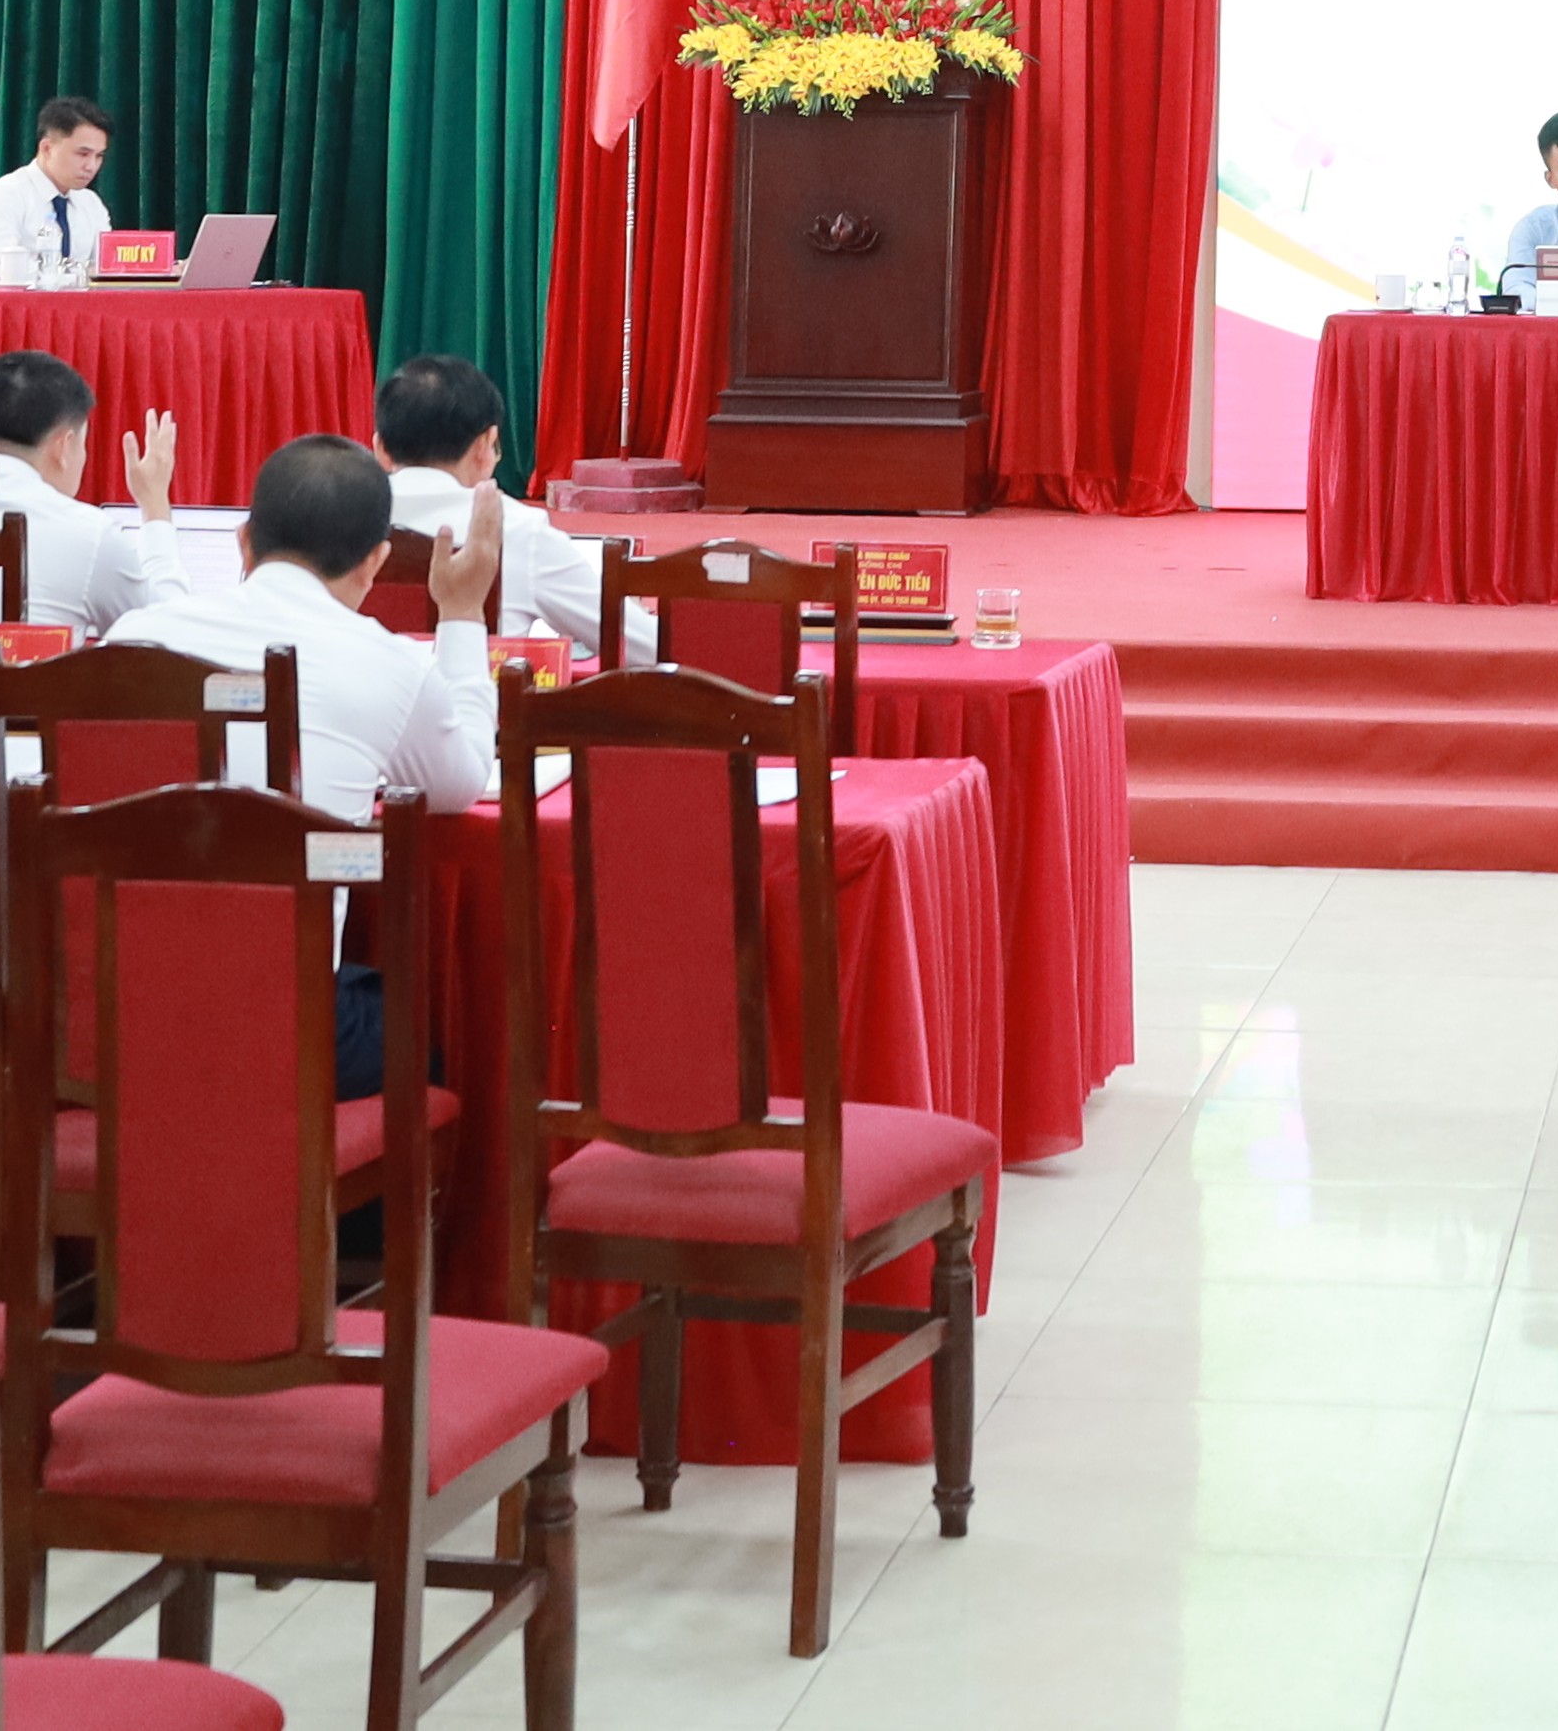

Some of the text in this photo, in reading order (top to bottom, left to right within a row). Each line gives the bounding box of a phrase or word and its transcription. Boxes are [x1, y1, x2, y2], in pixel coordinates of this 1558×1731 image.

[116, 242, 156, 263] THƯ KÝ
[878, 571, 902, 591] ĐỨC
[905, 570, 931, 592] TIẾN
